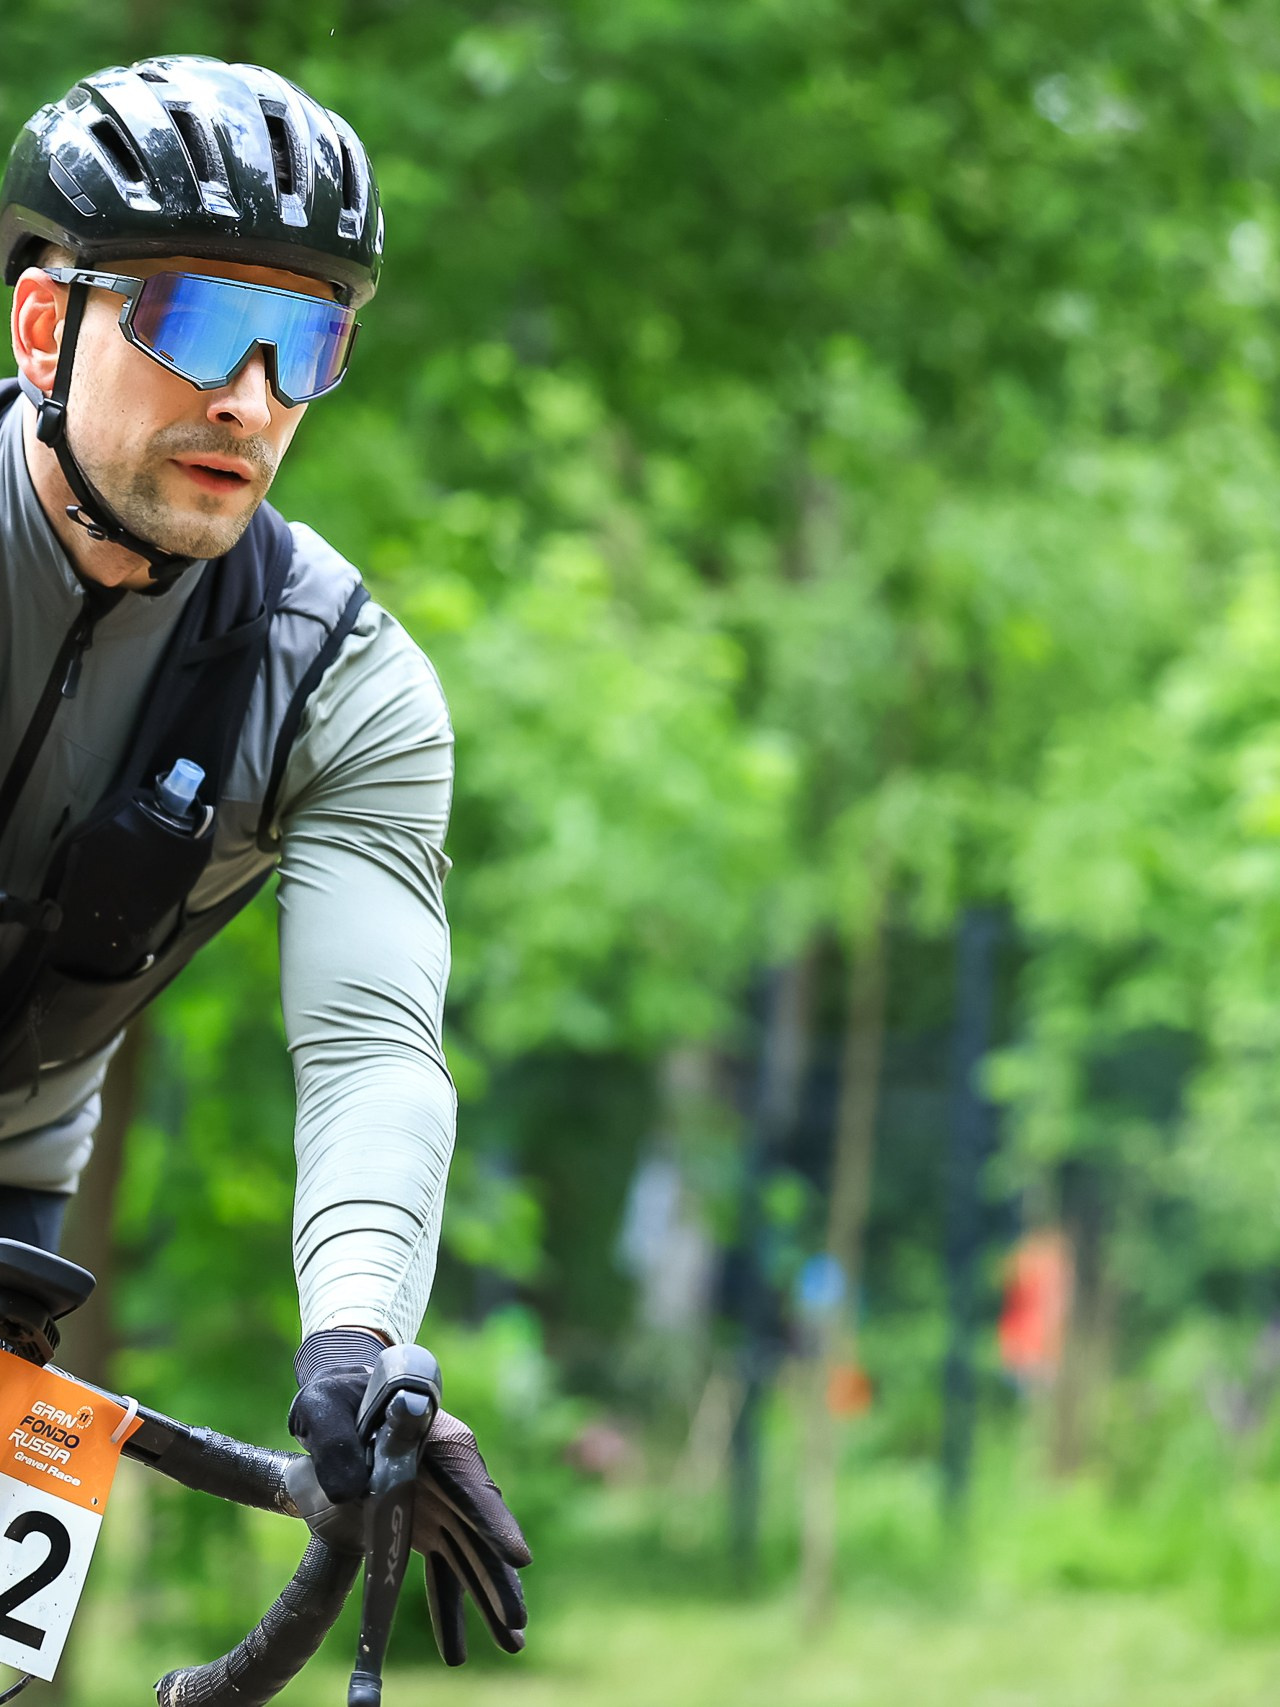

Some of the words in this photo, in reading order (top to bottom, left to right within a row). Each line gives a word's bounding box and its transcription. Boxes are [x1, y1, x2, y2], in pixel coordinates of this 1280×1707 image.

[20, 1415, 80, 1449] FONDO
[31, 1400, 78, 1429] GRAN
[78, 1412, 90, 1423] 11
[8, 1428, 71, 1465] RUSSIA
[14, 1451, 49, 1472] Gravel
[46, 1465, 82, 1487] Race
[384, 1504, 404, 1586] GRX
